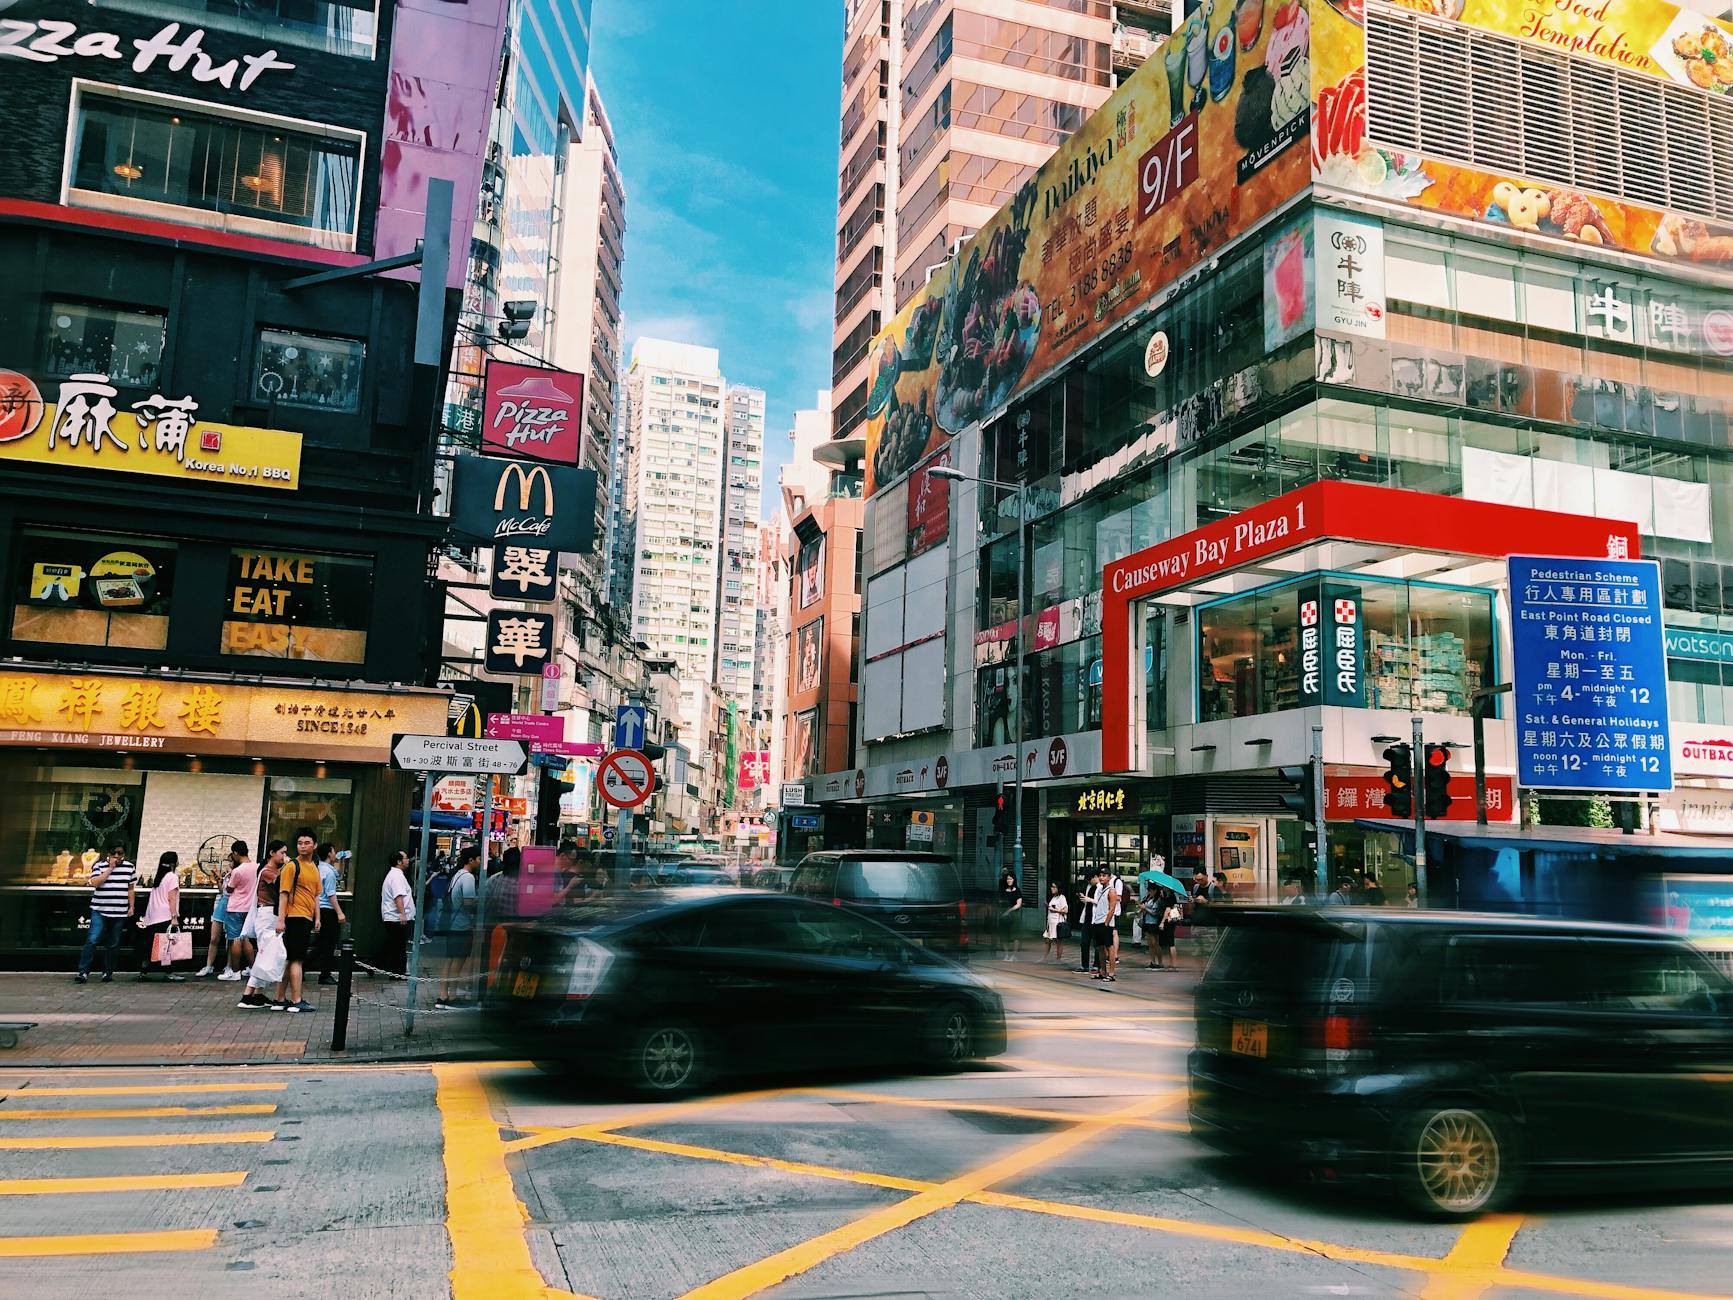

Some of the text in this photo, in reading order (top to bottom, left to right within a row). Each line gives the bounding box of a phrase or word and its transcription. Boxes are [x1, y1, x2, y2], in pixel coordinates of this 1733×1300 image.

[1520, 8, 1651, 69] Temptation
[132, 22, 295, 91] Hut
[1143, 123, 1194, 216] 9/F
[1337, 254, 1364, 304] 牛陣
[1334, 316, 1367, 328] GYU JIN
[1589, 286, 1693, 350] 牛陣
[49, 374, 199, 462] 麻蒲
[493, 400, 569, 428] Pizza
[505, 423, 565, 447] Hut
[185, 458, 291, 481] Korea No.1 BBQ
[1112, 501, 1306, 593] Causeway Bay Plaza 1
[240, 552, 314, 584] TAKE
[1531, 569, 1639, 583] Pedestrian Scheme
[233, 586, 292, 617] EAT
[1525, 584, 1647, 605] 行人專用區計劃
[1520, 610, 1652, 624] East Point Road Closed
[229, 620, 312, 653] EASY
[1544, 624, 1632, 643] 東角道封閉
[1560, 650, 1589, 660] Mon.
[1598, 651, 1617, 661] Fri.
[1547, 663, 1635, 681] 星期一至五
[1533, 693, 1617, 708] 下午 午夜
[1538, 683, 1553, 691] pm
[1582, 684, 1626, 694] midnight
[1630, 688, 1650, 704] 12
[1525, 714, 1660, 728] Sat. & General Holidays
[11, 730, 166, 748] FENG XIANG JEWELLERY
[423, 740, 499, 752] Percival Street
[1523, 730, 1665, 750] 星期六及公眾假期
[430, 755, 489, 768] 波斯富街
[1050, 748, 1065, 767] 3/F
[1533, 752, 1558, 761] noon
[1592, 753, 1637, 763] midnight
[1640, 756, 1660, 772] 12
[936, 766, 948, 779] 3/F
[1533, 763, 1627, 777] 中午 午夜
[1078, 788, 1125, 811] 北京同仁堂
